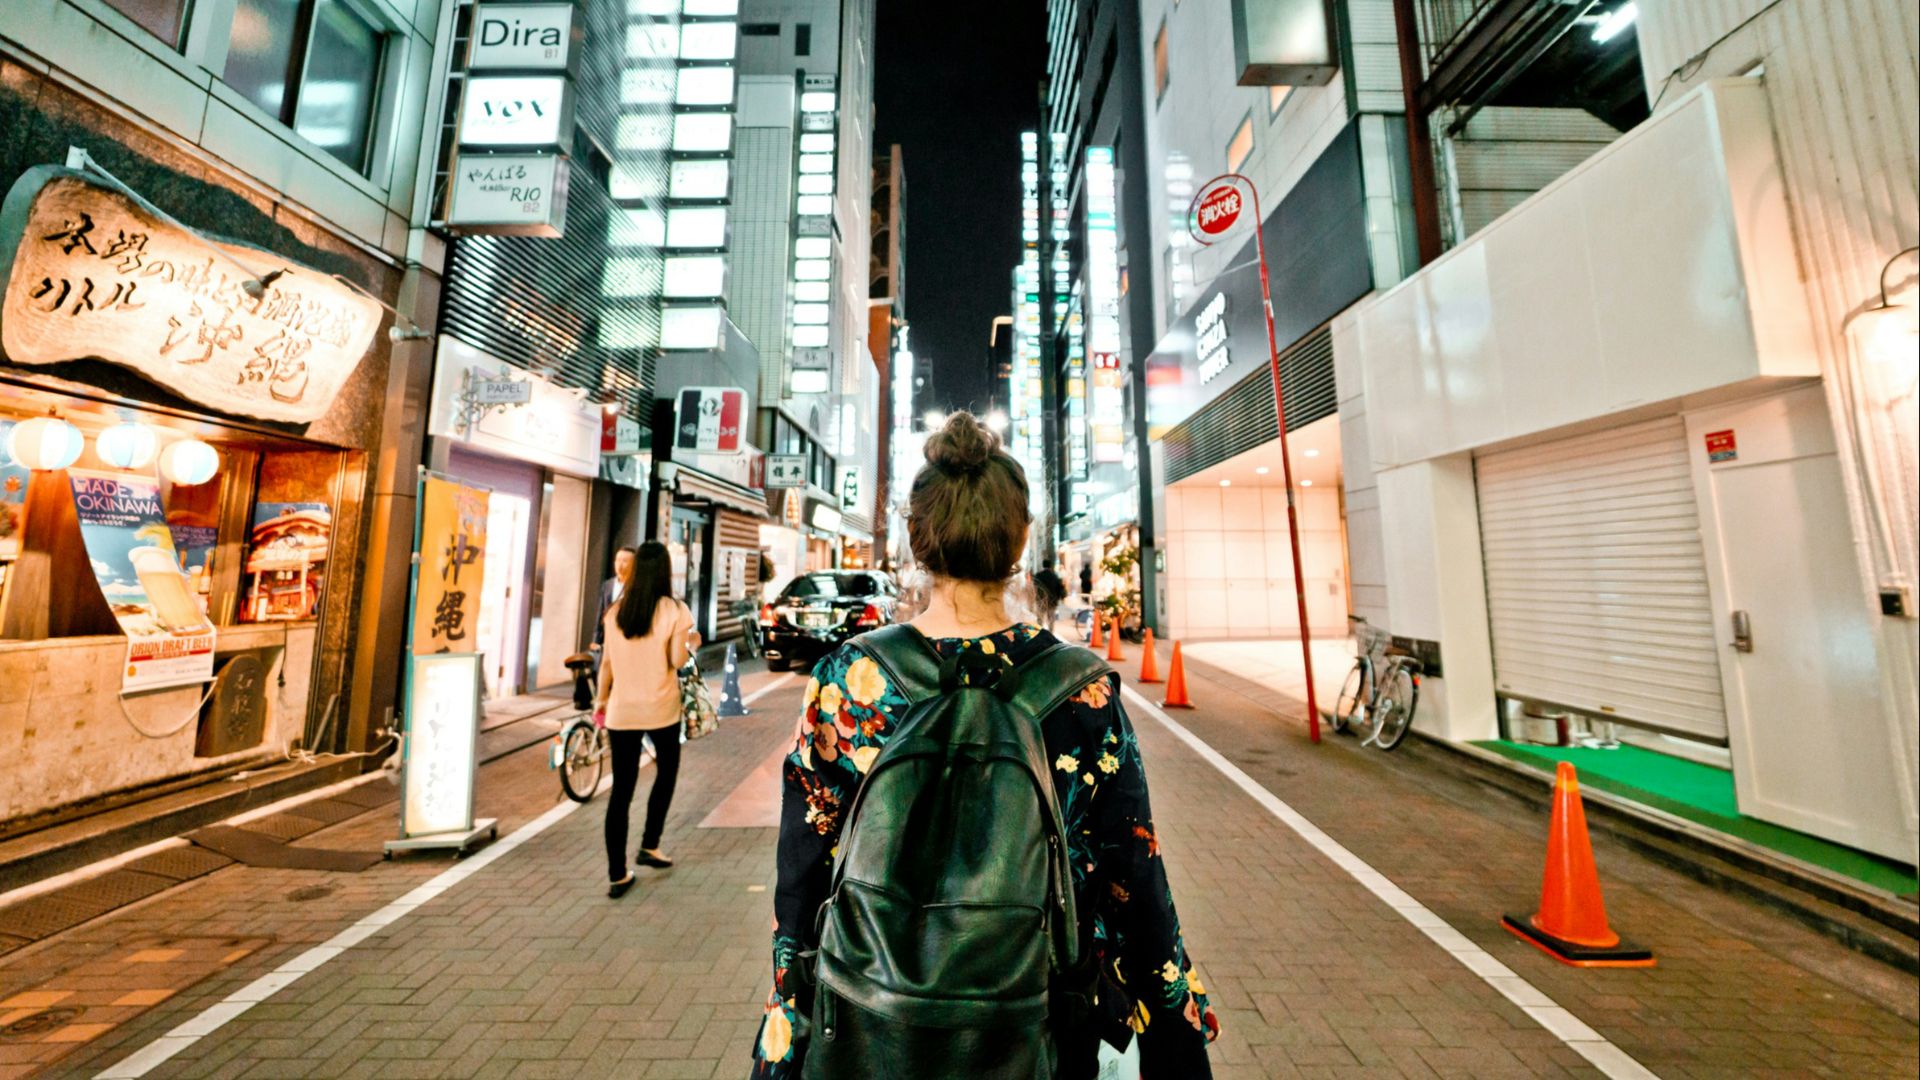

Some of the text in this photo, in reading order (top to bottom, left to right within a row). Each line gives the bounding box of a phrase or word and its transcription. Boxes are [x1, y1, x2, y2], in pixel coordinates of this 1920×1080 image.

[480, 18, 561, 47] Dira
[544, 49, 559, 59] B1
[467, 165, 527, 182] やんばる
[509, 186, 542, 203] RIO
[522, 202, 541, 213] B2
[1200, 193, 1239, 227] 消火栓
[29, 276, 313, 404] リトル 沖縄
[486, 383, 523, 394] PAPEL
[77, 494, 163, 516] OKINAWA
[432, 533, 480, 653] 沖縄
[131, 640, 161, 657] ORION
